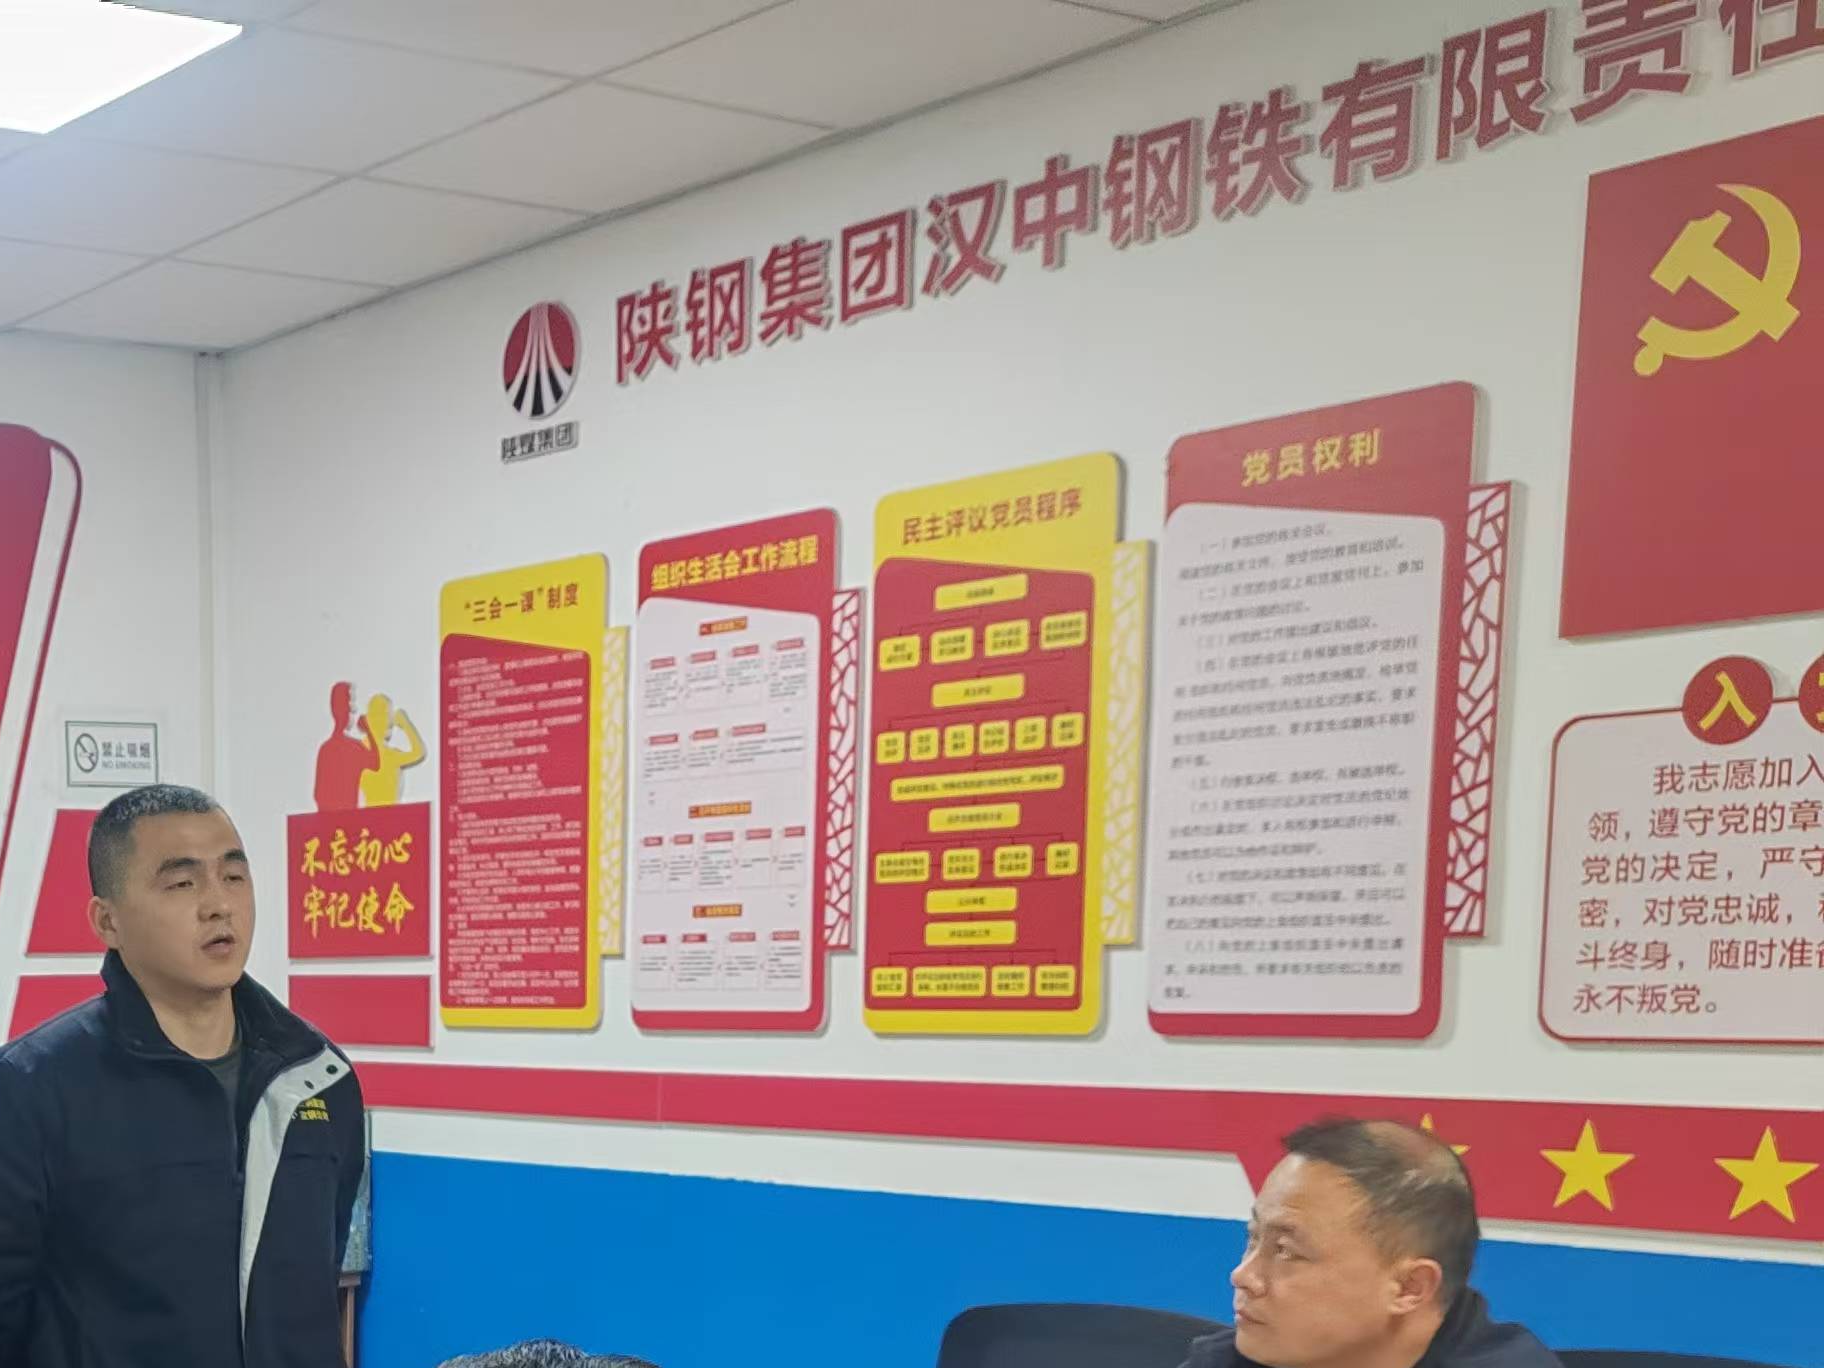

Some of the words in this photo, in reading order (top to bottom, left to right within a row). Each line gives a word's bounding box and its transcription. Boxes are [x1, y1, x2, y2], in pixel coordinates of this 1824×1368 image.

[1241, 427, 1382, 488] 党员权利
[901, 487, 1083, 546] 民主评议党员程序
[651, 533, 819, 591] 组织生活会工作流程
[464, 581, 579, 623] “三会一课”制度
[1652, 754, 1824, 796] 我志愿加入
[1587, 799, 1823, 842] 领，遵守党的章
[301, 828, 413, 877] 不忘初心
[303, 882, 415, 938] 牢记使命
[1578, 890, 1824, 930] 密，对党忠诚，
[1576, 934, 1824, 974] 斗终身，随时准
[1572, 982, 1718, 1017] 永不叛党。
